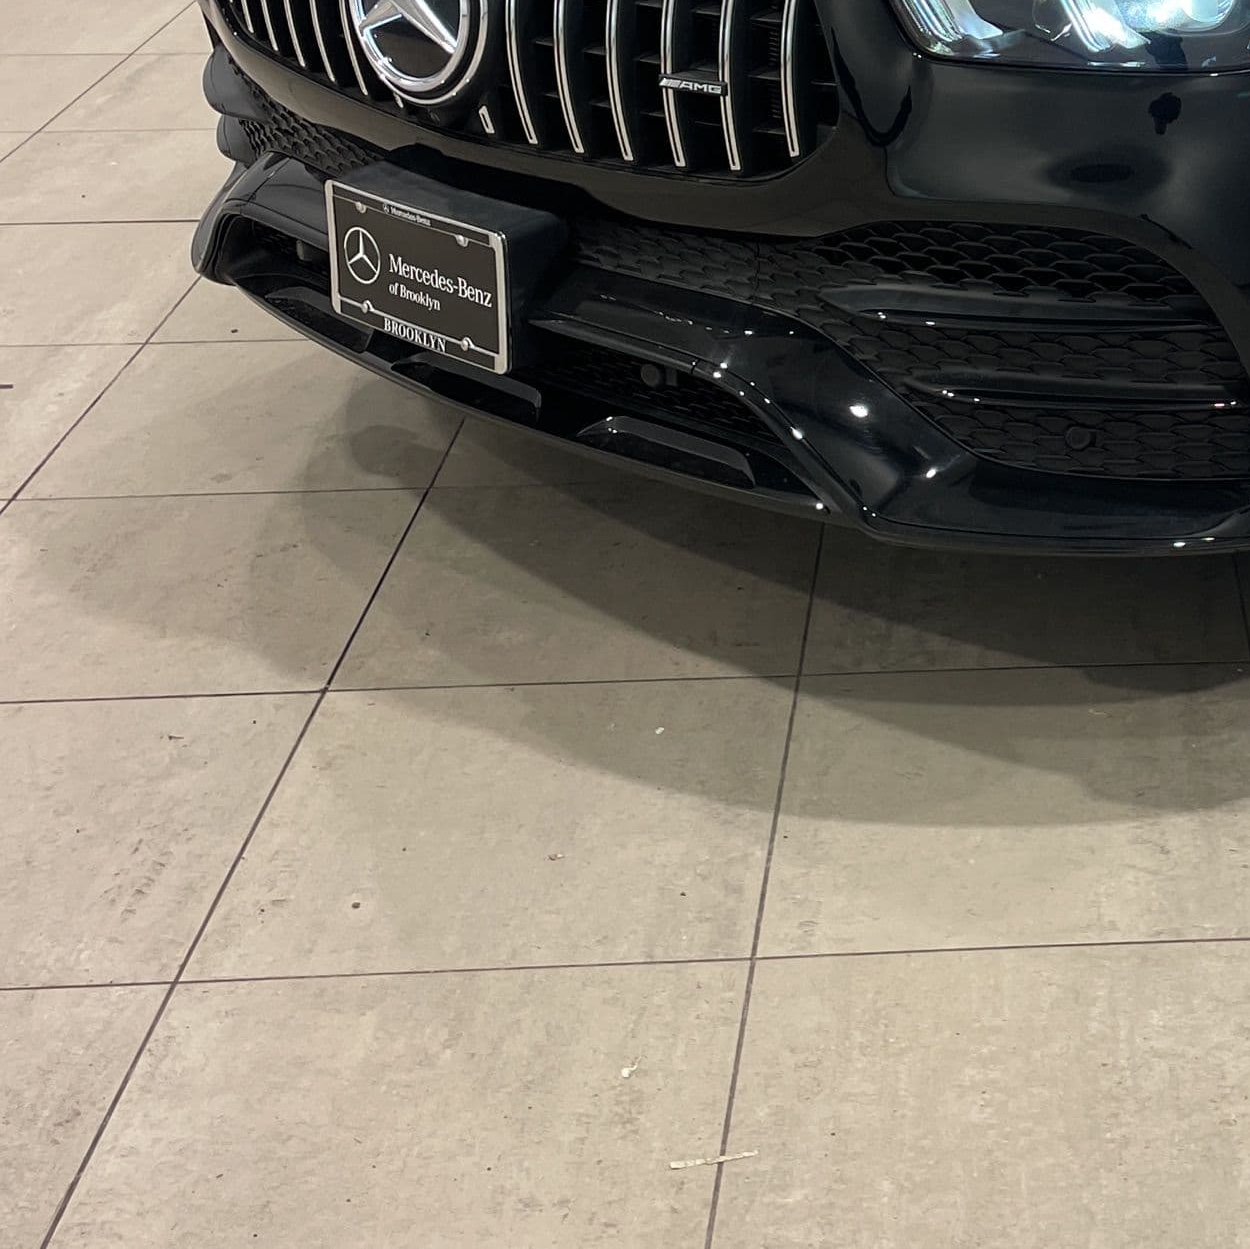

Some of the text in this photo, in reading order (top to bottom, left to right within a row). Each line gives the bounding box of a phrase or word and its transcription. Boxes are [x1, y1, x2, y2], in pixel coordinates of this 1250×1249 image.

[680, 81, 722, 94] AMG
[388, 253, 493, 308] Mercedes-Benz
[388, 282, 441, 311] of Brooklyn
[384, 317, 446, 352] BROOKLYN
